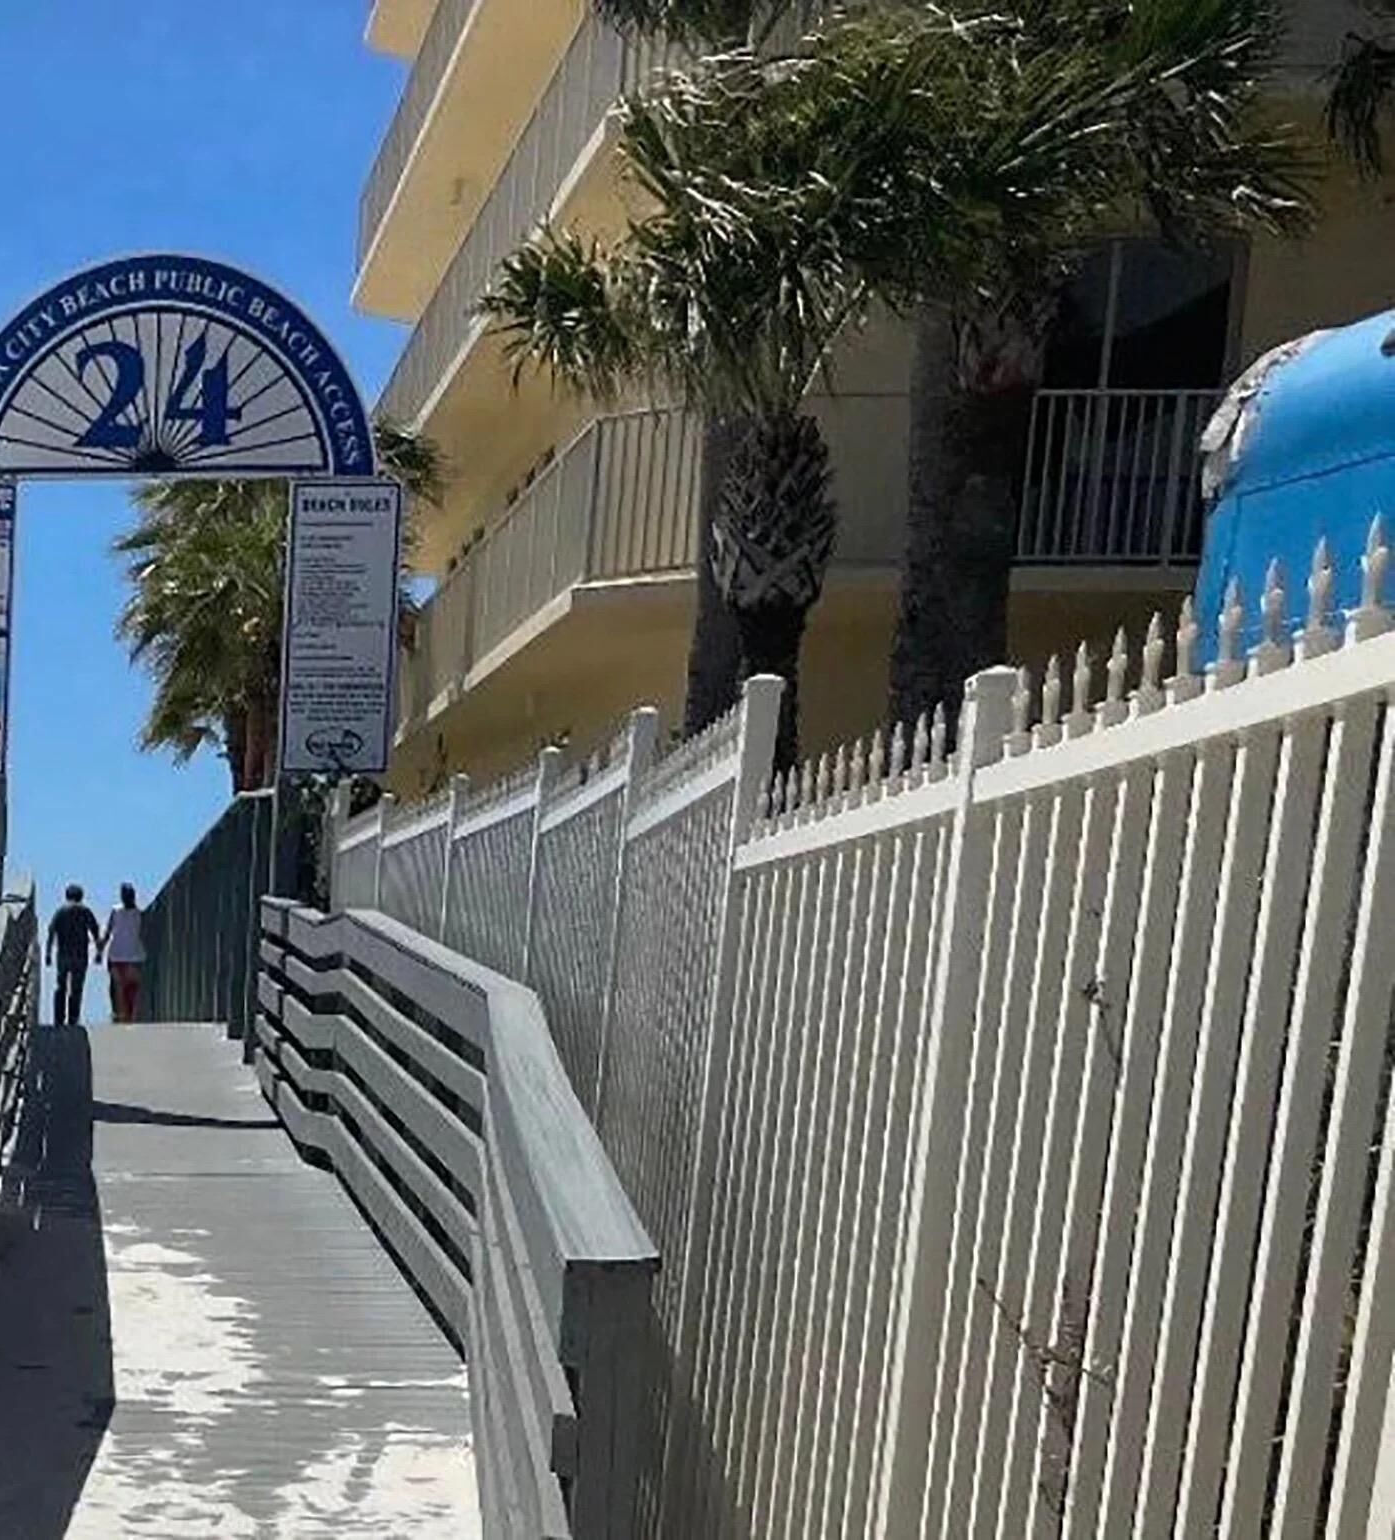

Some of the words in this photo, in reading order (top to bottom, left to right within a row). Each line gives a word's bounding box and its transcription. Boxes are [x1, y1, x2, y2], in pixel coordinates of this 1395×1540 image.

[6, 306, 55, 360] CITY
[59, 270, 145, 316] BEACH
[154, 269, 247, 307] PUBLIC
[248, 298, 320, 367] BEACH
[314, 370, 361, 466] ACCESS
[72, 330, 243, 447] 24
